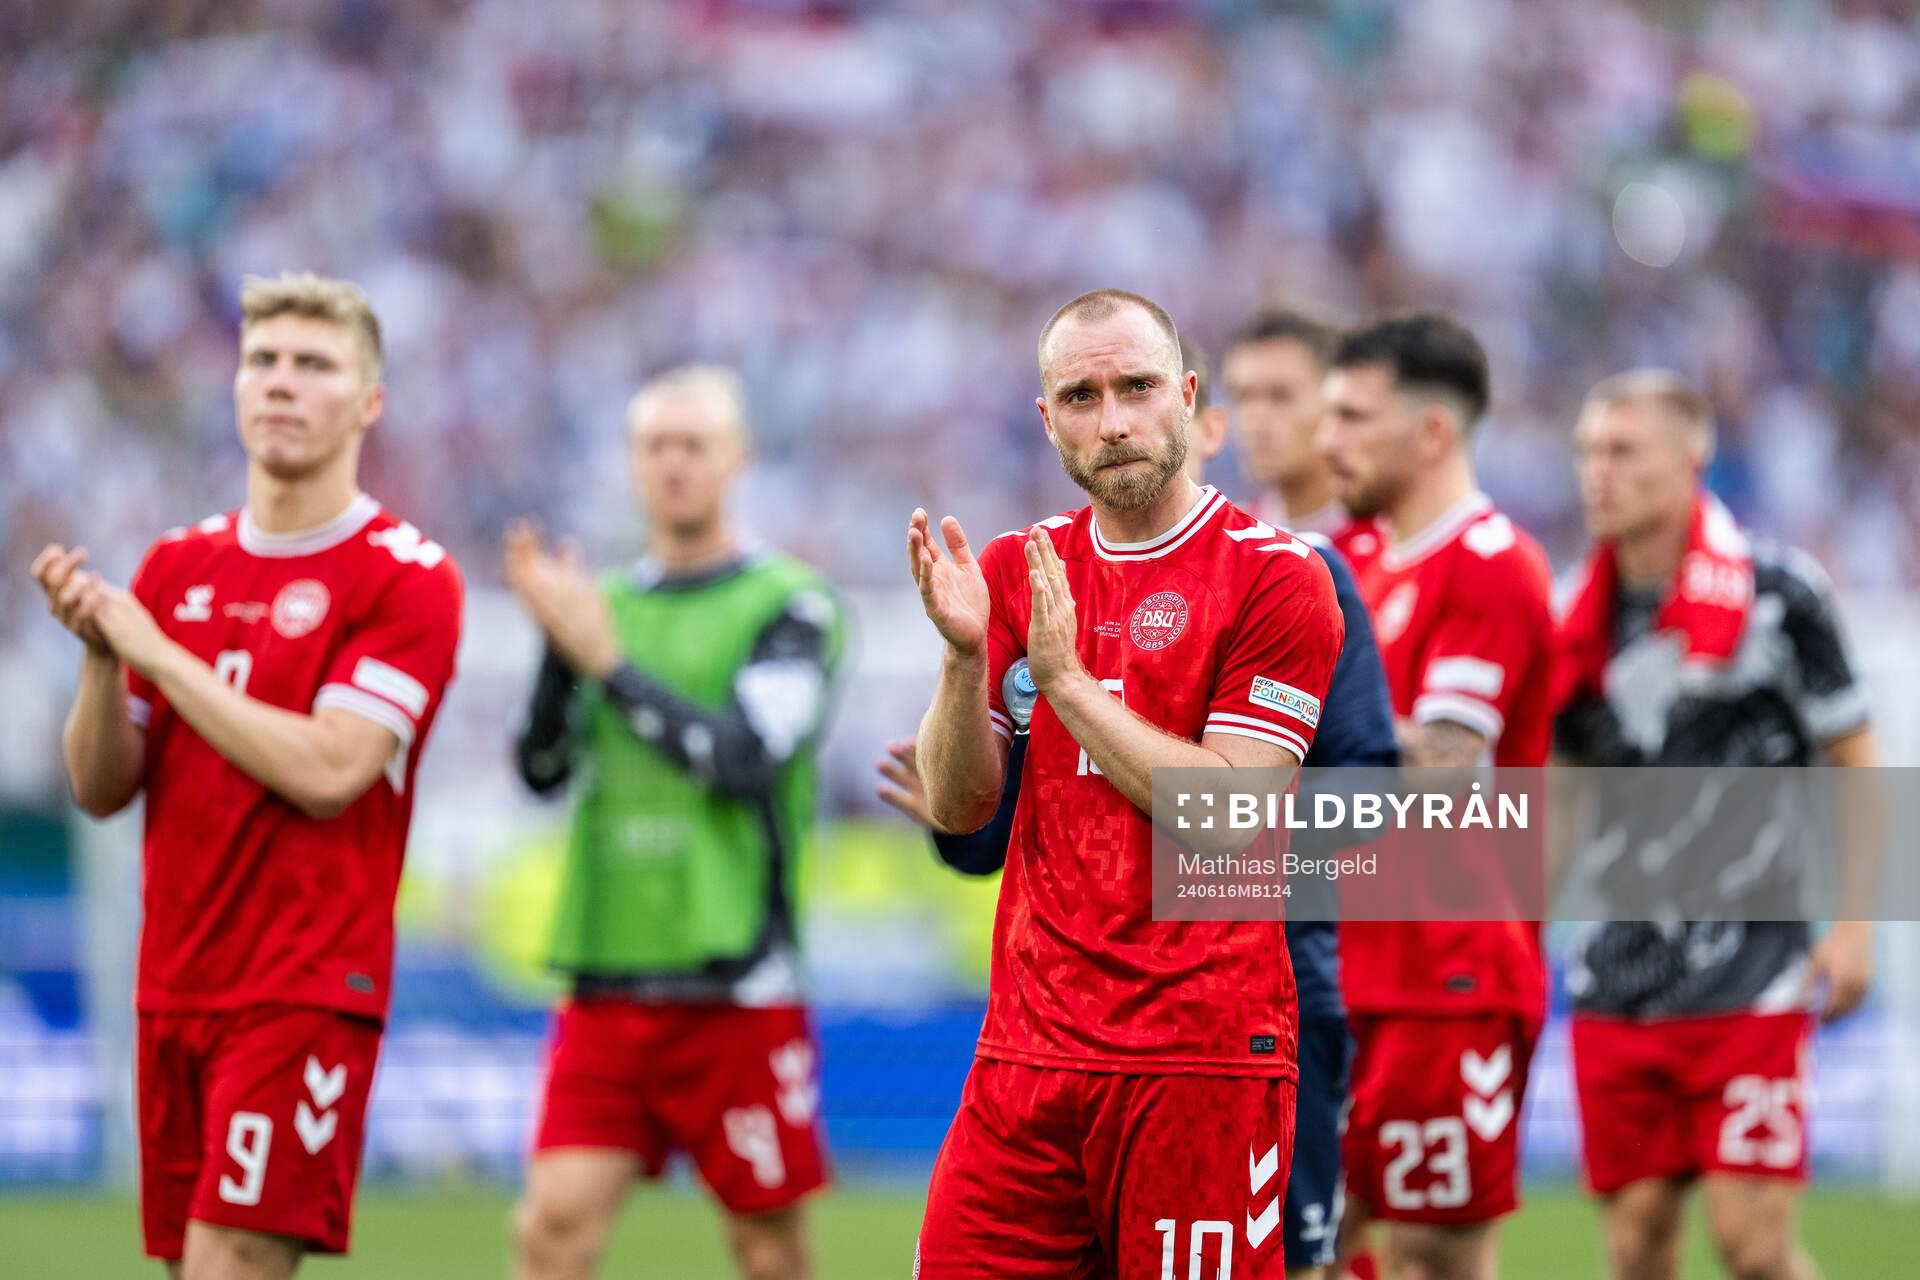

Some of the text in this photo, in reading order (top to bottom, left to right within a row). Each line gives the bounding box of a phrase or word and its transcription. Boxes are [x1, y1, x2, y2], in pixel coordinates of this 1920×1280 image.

[1132, 607, 1145, 641] DANSK
[1141, 610, 1176, 628] DBU
[1166, 611, 1186, 642] UNION
[1141, 640, 1164, 649] 1889
[1255, 677, 1274, 688] UEFA
[1252, 684, 1319, 719] FOUNDATION
[219, 1111, 273, 1206] 9
[1379, 1116, 1472, 1210] 23
